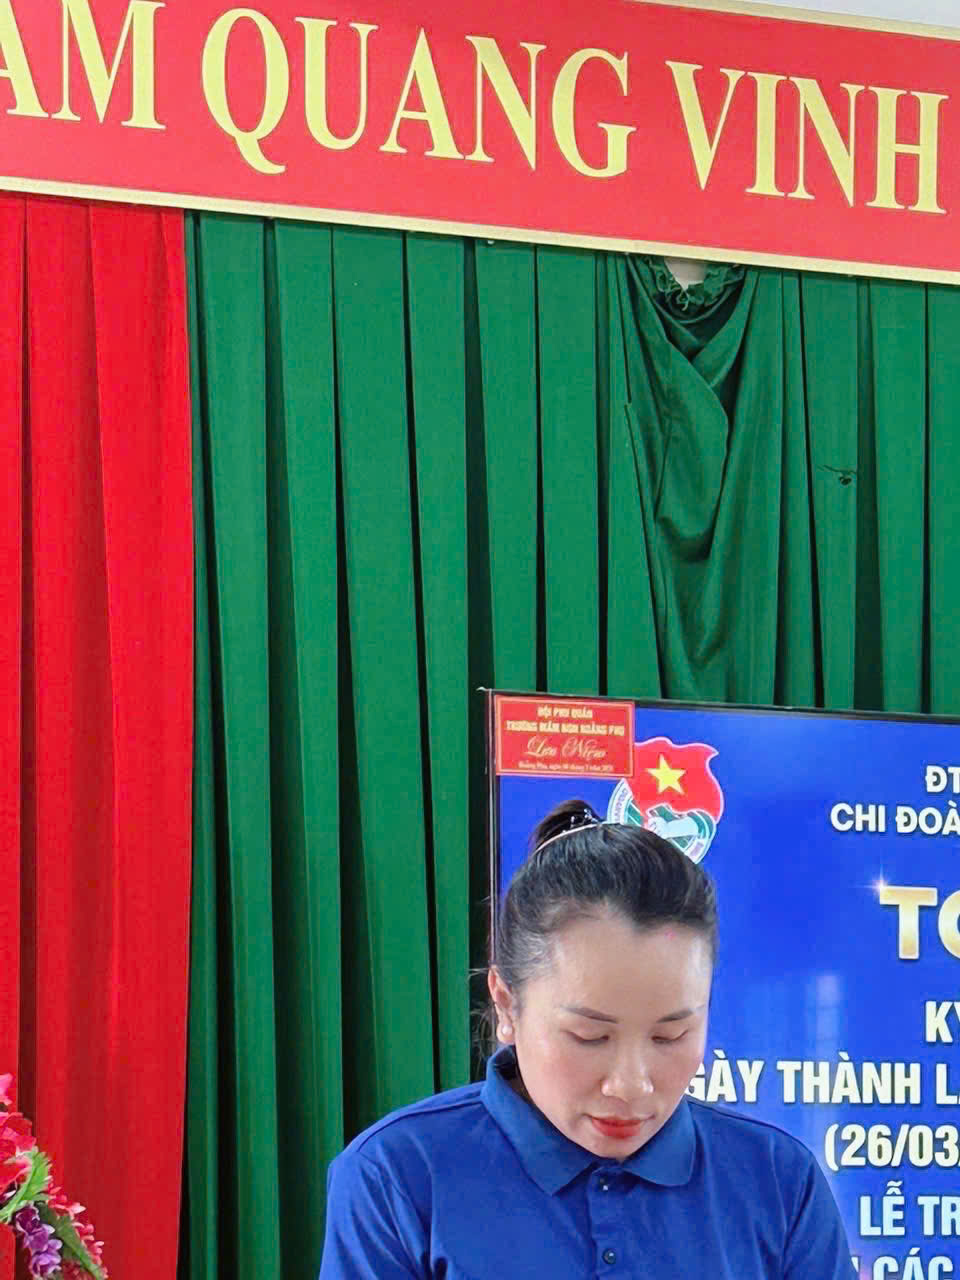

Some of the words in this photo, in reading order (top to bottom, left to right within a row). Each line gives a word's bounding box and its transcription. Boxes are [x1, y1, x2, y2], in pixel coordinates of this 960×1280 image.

[201, 8, 637, 178] QUANG
[666, 60, 950, 215] VINH
[830, 803, 885, 832] CHI
[776, 1052, 920, 1104] THÀNH
[860, 1180, 905, 1236] LỄ
